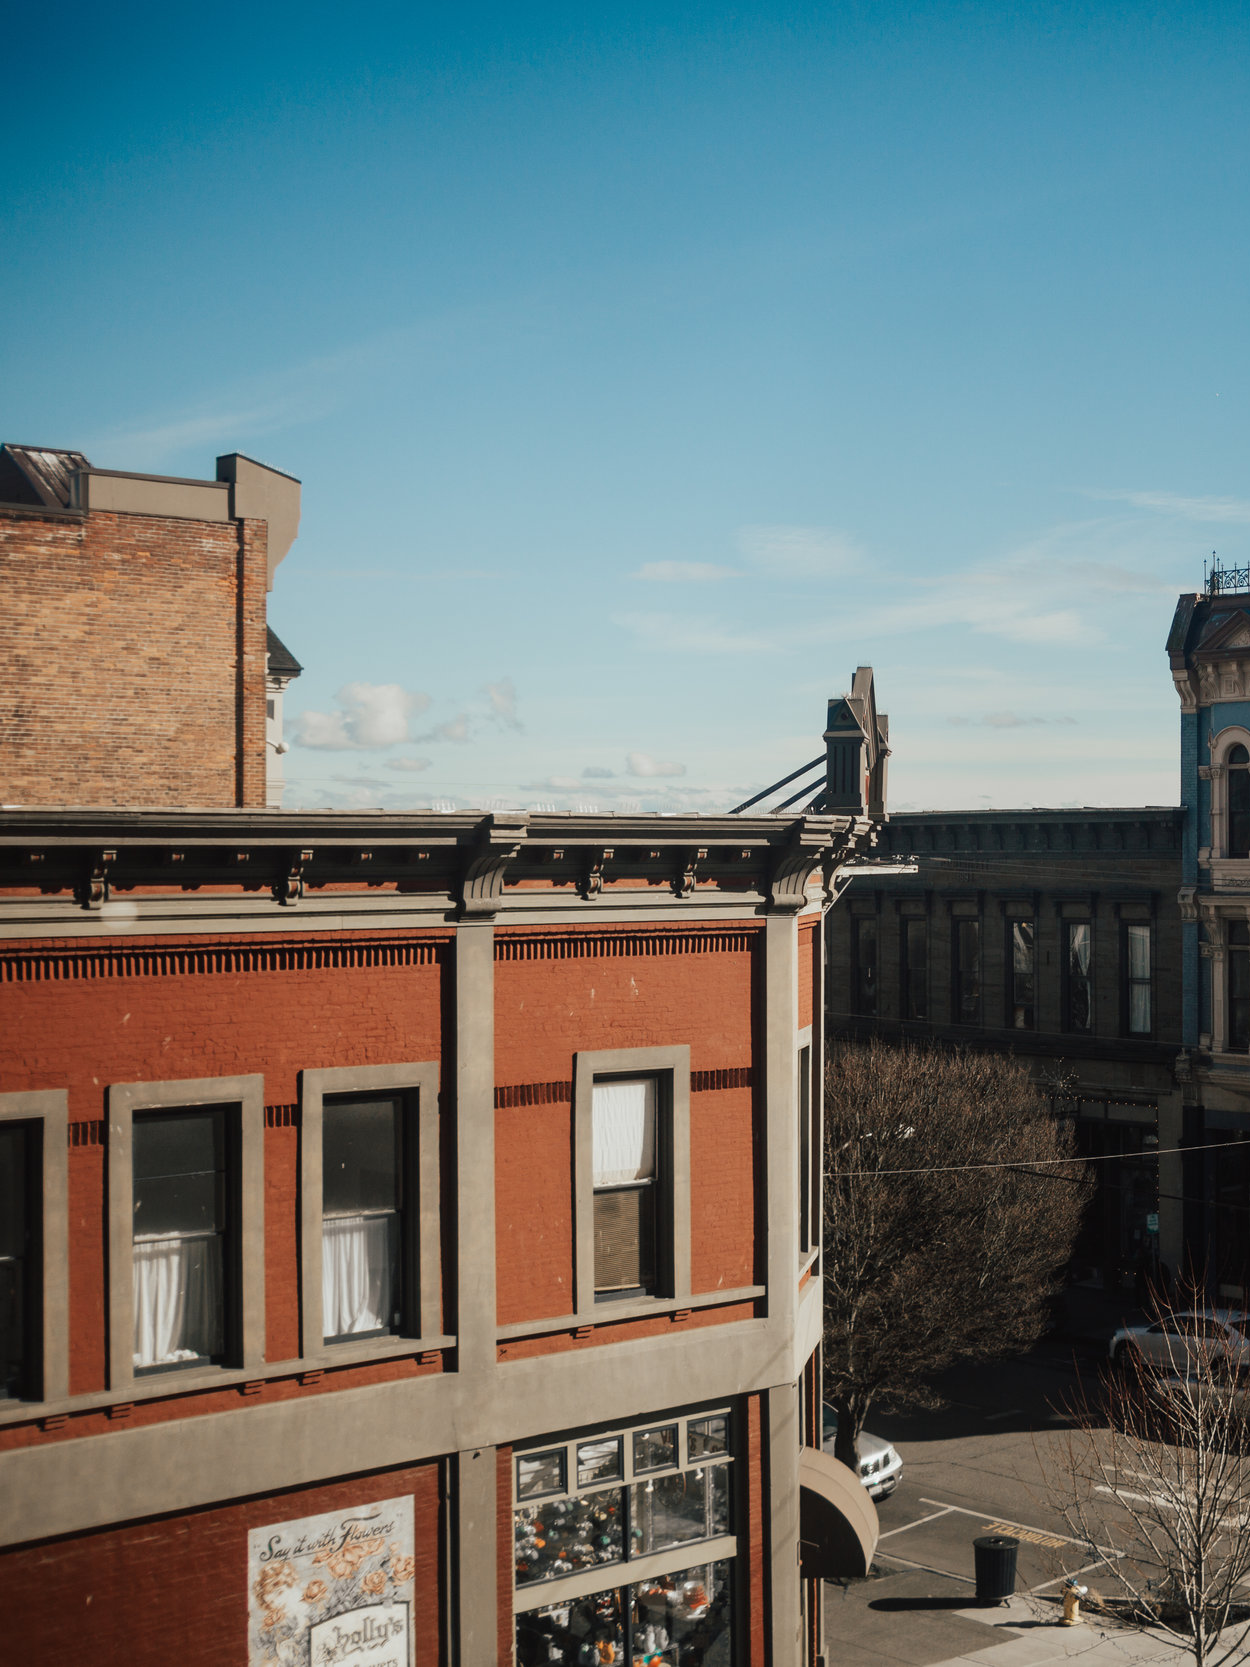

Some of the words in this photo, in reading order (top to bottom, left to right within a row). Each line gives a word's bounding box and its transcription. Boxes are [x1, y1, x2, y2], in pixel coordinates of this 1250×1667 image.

[259, 1535, 291, 1562] Say
[293, 1534, 307, 1555] it
[307, 1525, 336, 1550] with
[329, 1511, 395, 1552] Flowers
